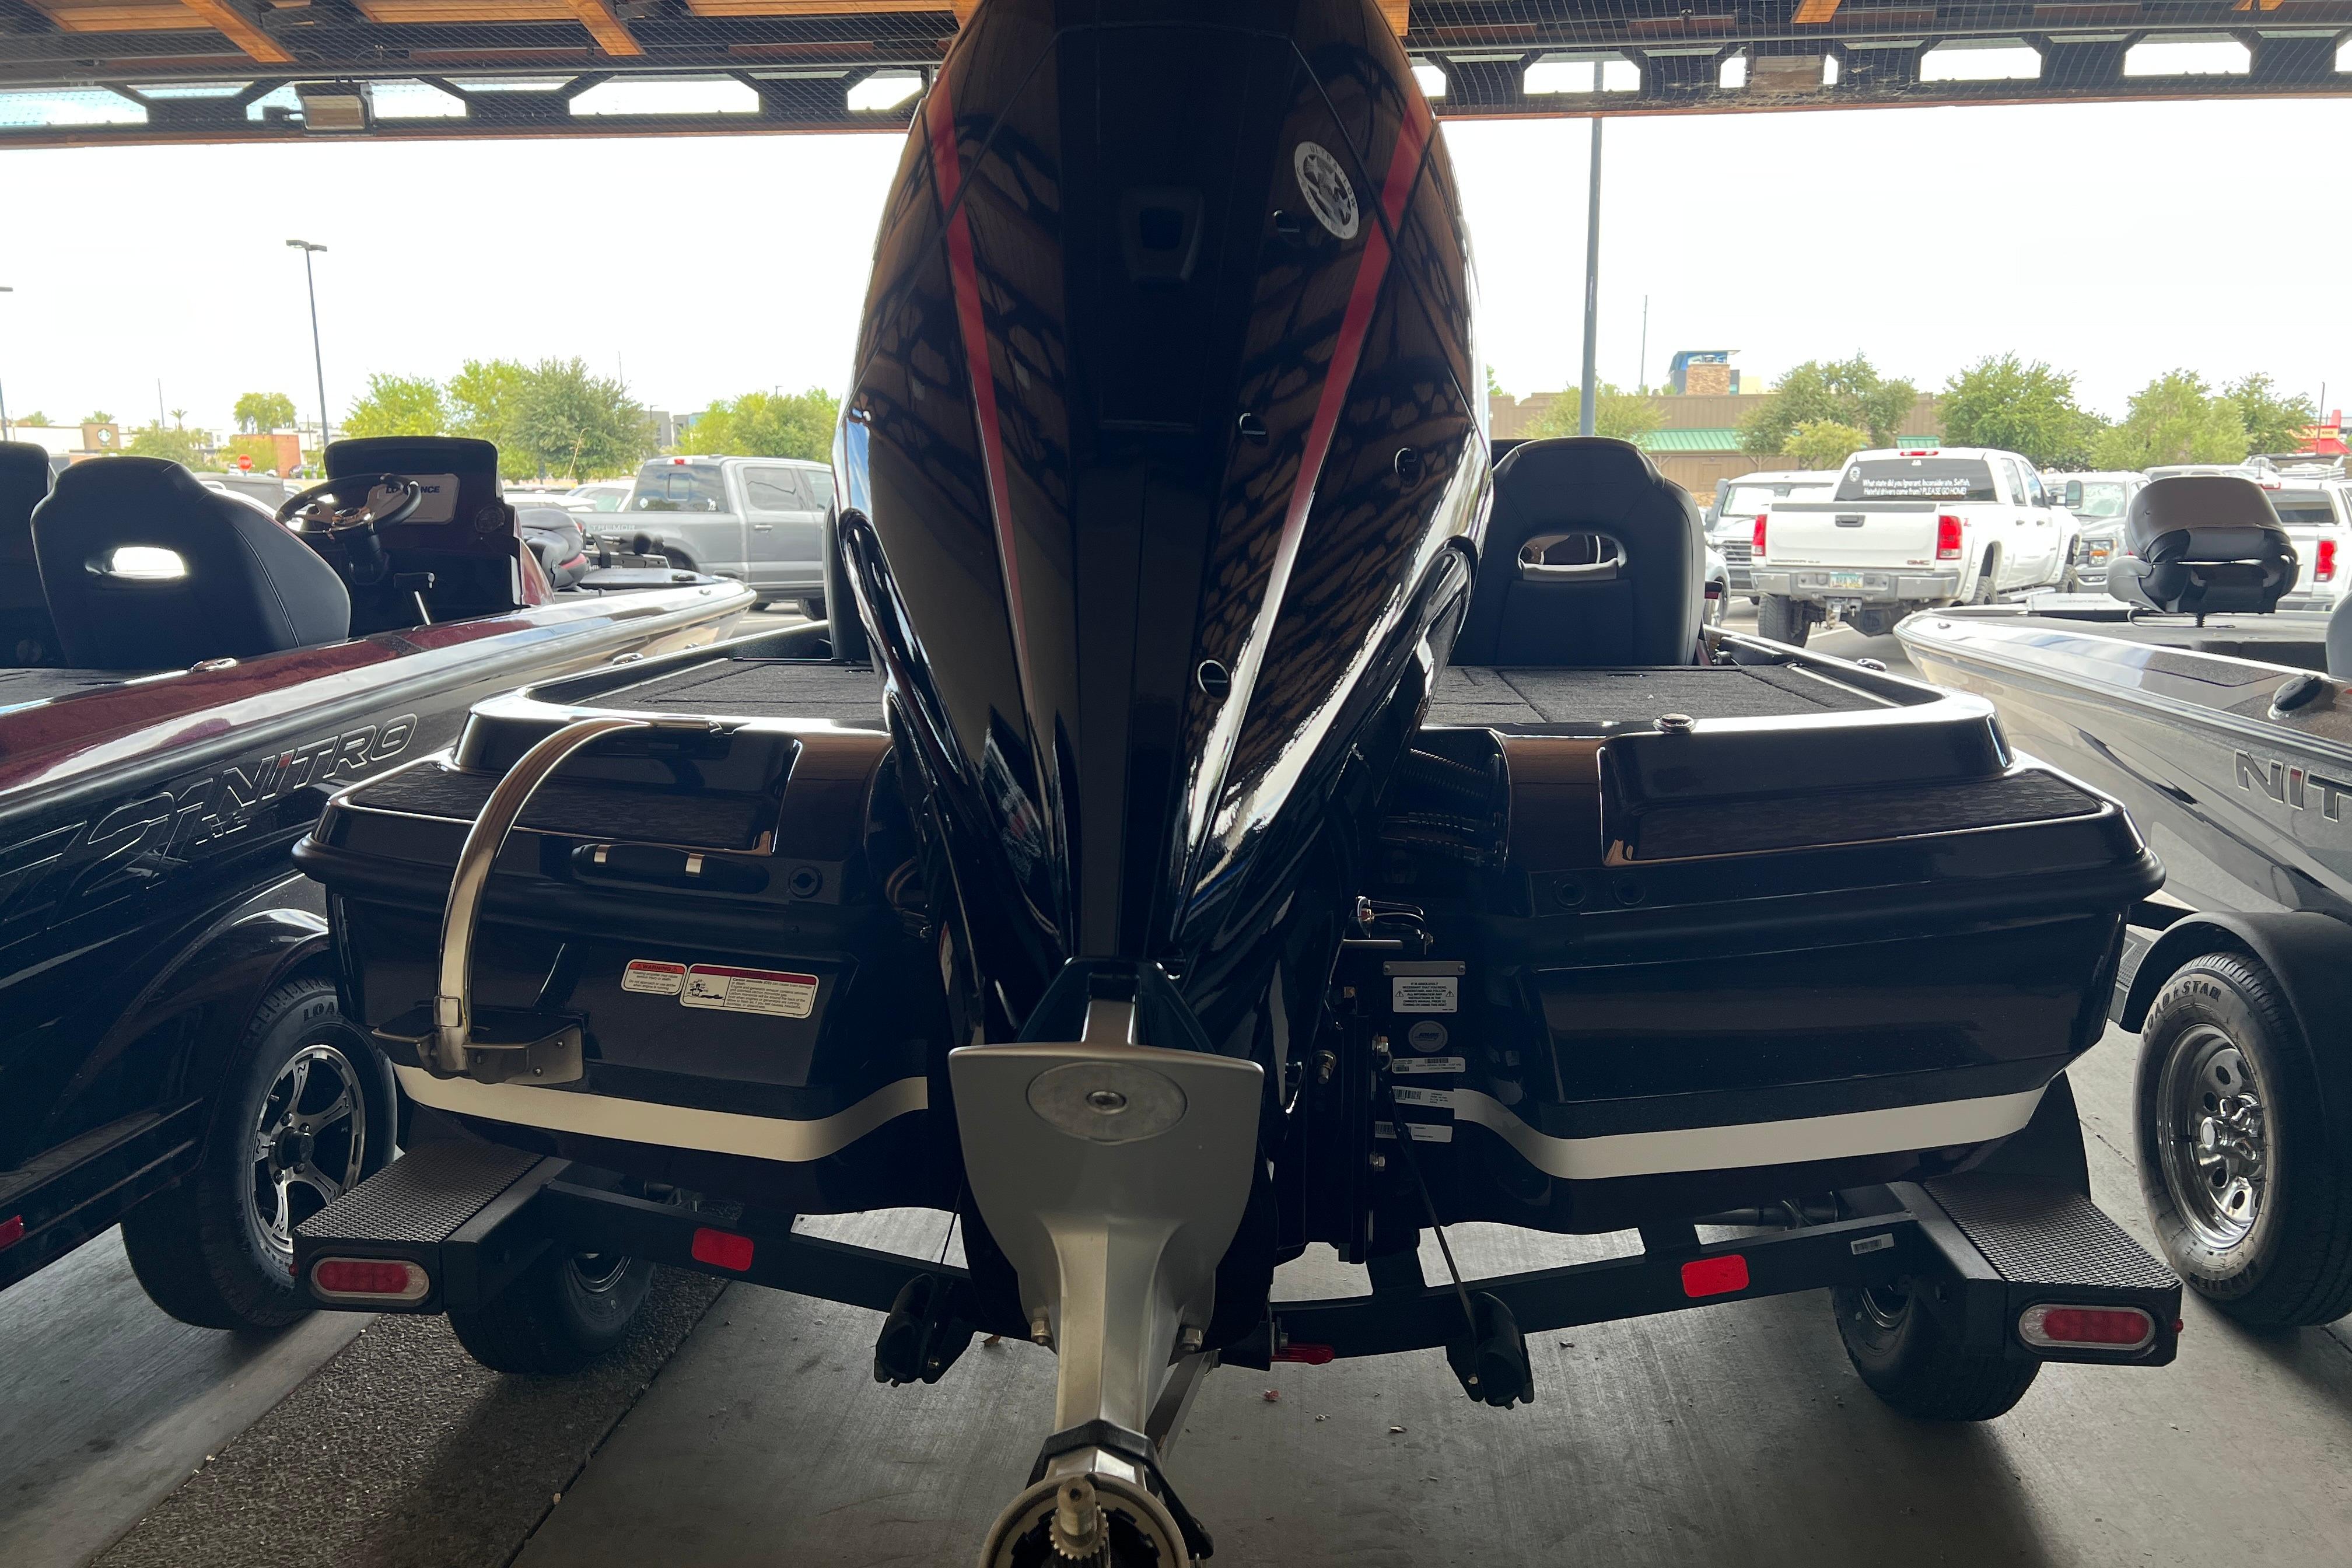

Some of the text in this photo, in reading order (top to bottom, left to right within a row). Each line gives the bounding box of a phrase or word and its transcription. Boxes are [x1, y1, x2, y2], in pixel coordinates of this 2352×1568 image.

[1922, 487, 1941, 495] PLEASE
[1941, 487, 1950, 495] GO
[211, 713, 418, 808] NITRO
[303, 1002, 341, 1022] LOA
